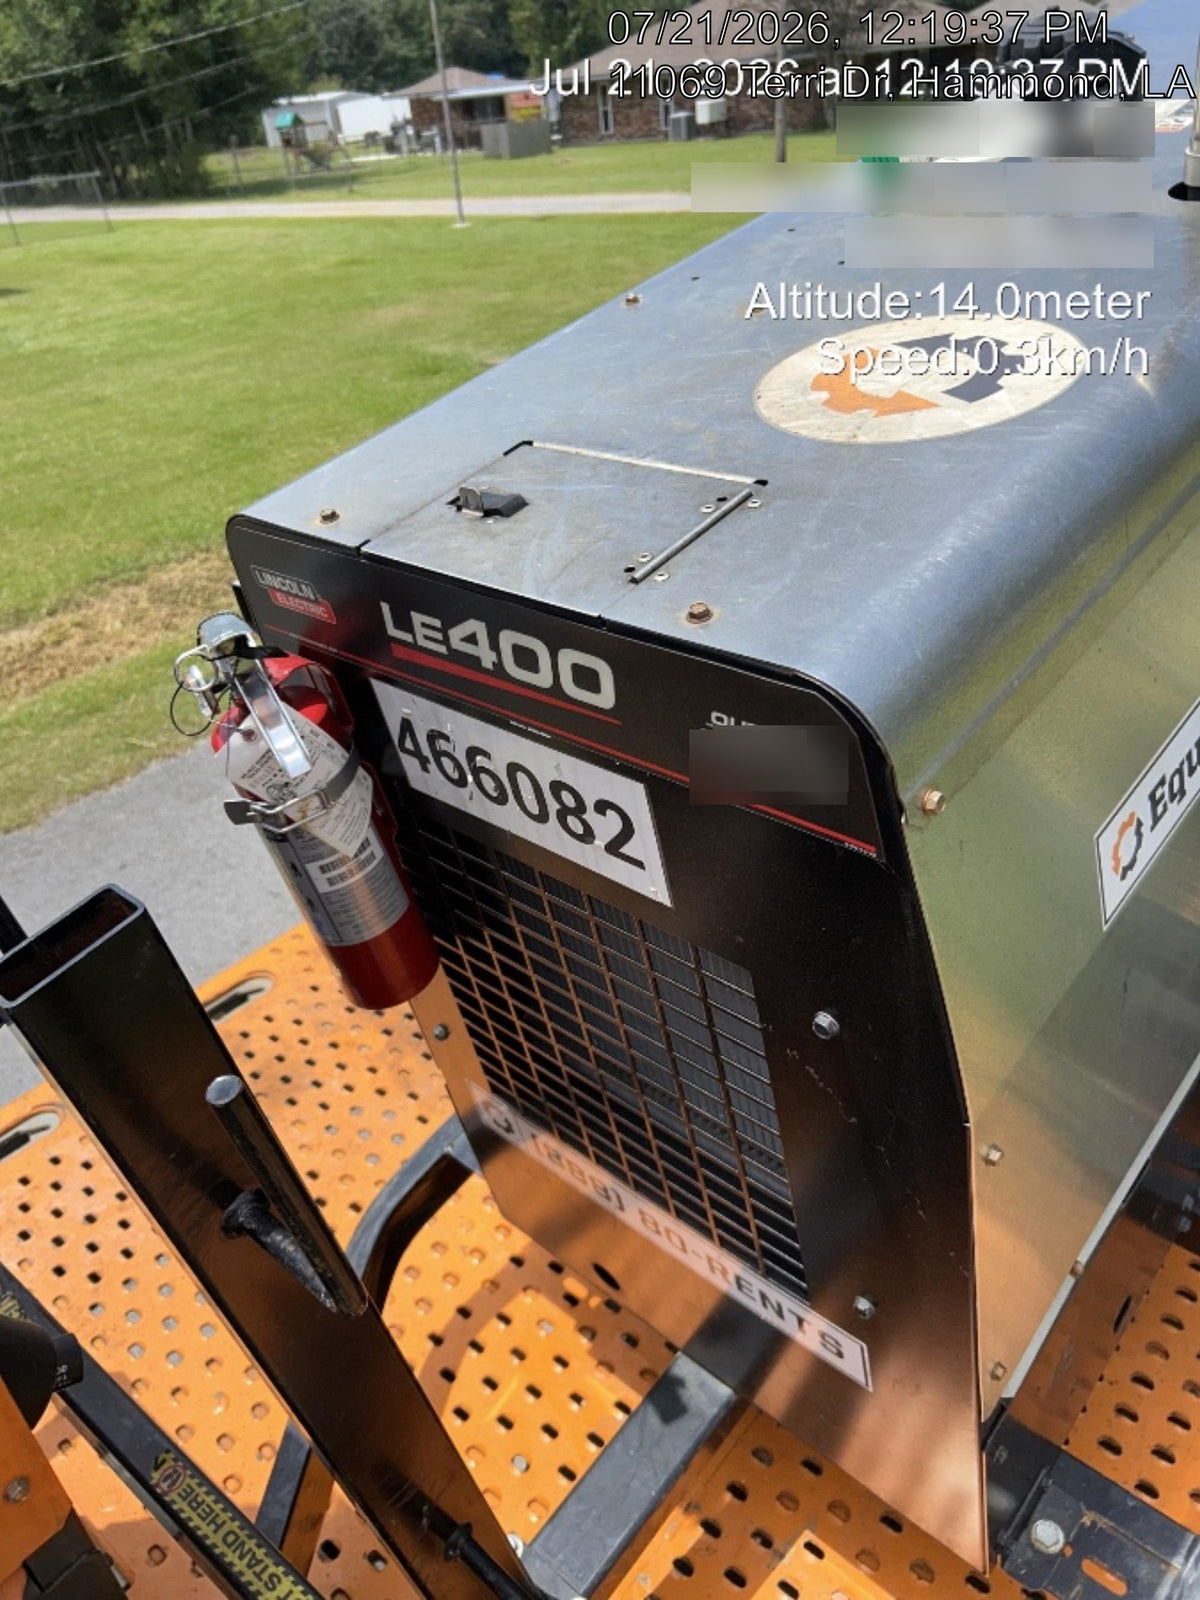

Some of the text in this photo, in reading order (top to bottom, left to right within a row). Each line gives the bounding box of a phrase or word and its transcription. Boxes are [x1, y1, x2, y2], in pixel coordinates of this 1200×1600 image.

[254, 569, 316, 601] LINCOLN
[276, 593, 330, 618] ELECTRIC
[379, 601, 616, 710] LE400
[397, 716, 647, 872] 466082
[637, 1208, 846, 1360] 80-RENTS
[178, 1485, 282, 1592] STAND HERE
